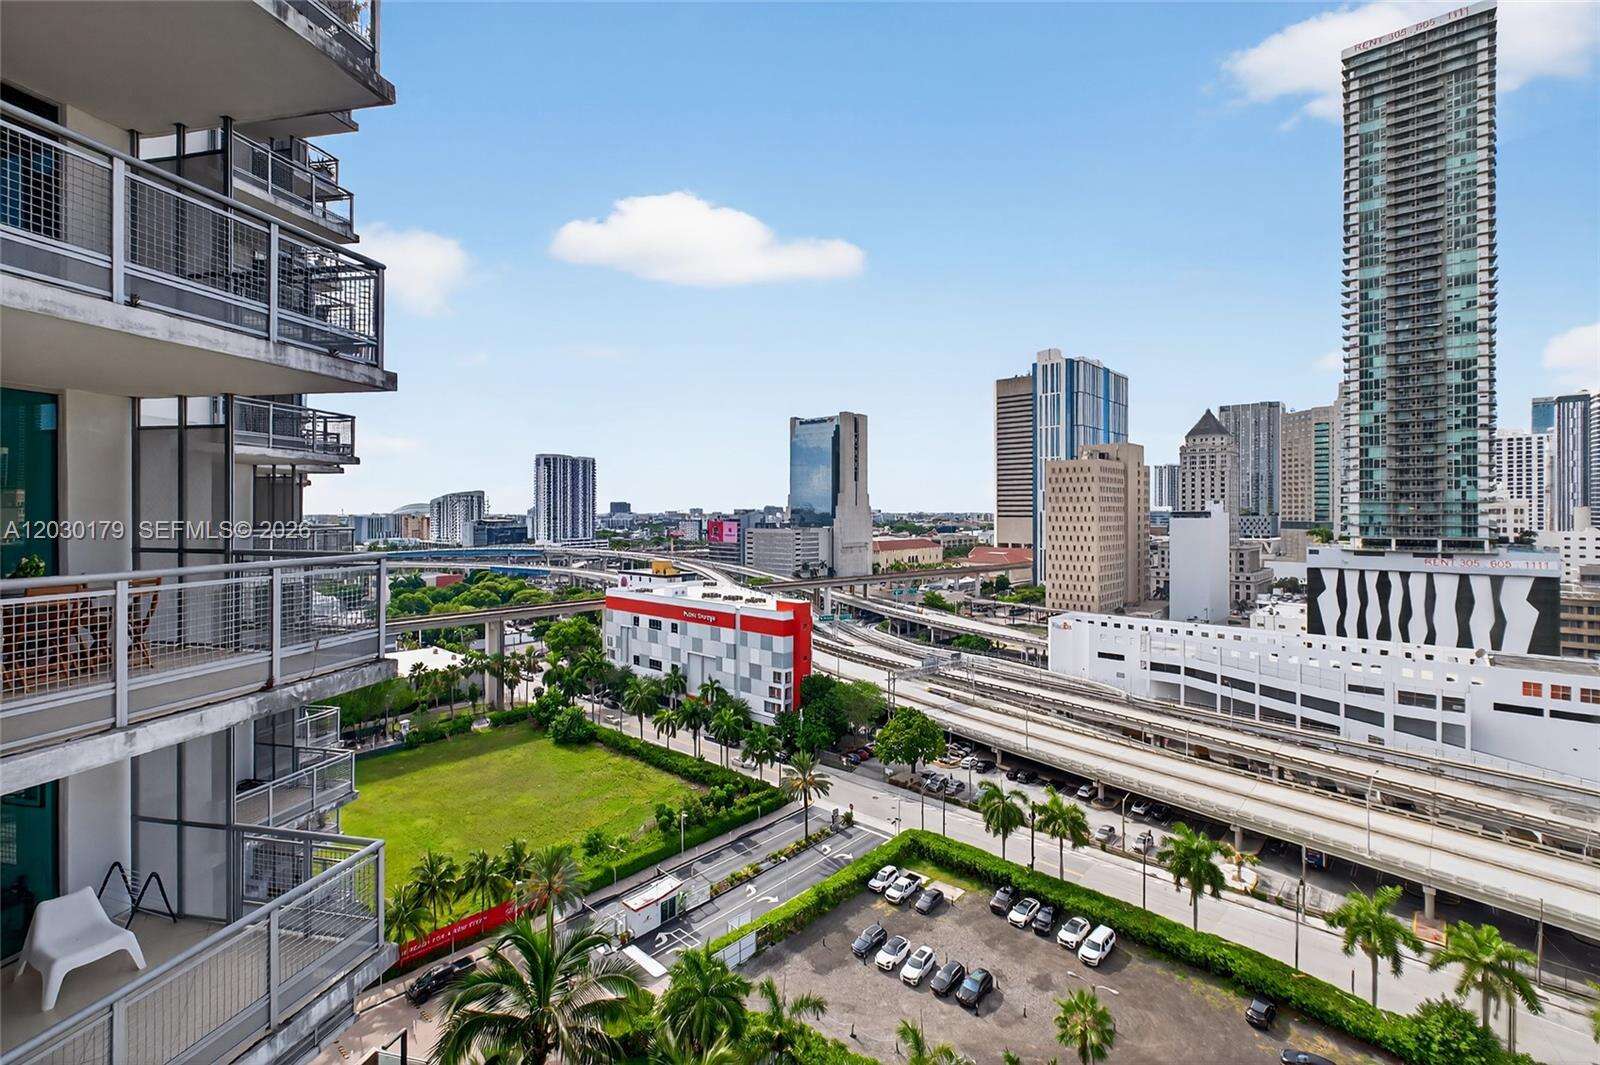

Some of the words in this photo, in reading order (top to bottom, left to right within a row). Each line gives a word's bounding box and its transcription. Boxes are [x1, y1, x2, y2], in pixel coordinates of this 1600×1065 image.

[1354, 37, 1384, 51] RENT
[1389, 28, 1407, 40] 305
[1424, 558, 1455, 567] RENT
[1460, 559, 1480, 568] 305
[1490, 560, 1512, 569] 605
[1525, 561, 1550, 569] 1111
